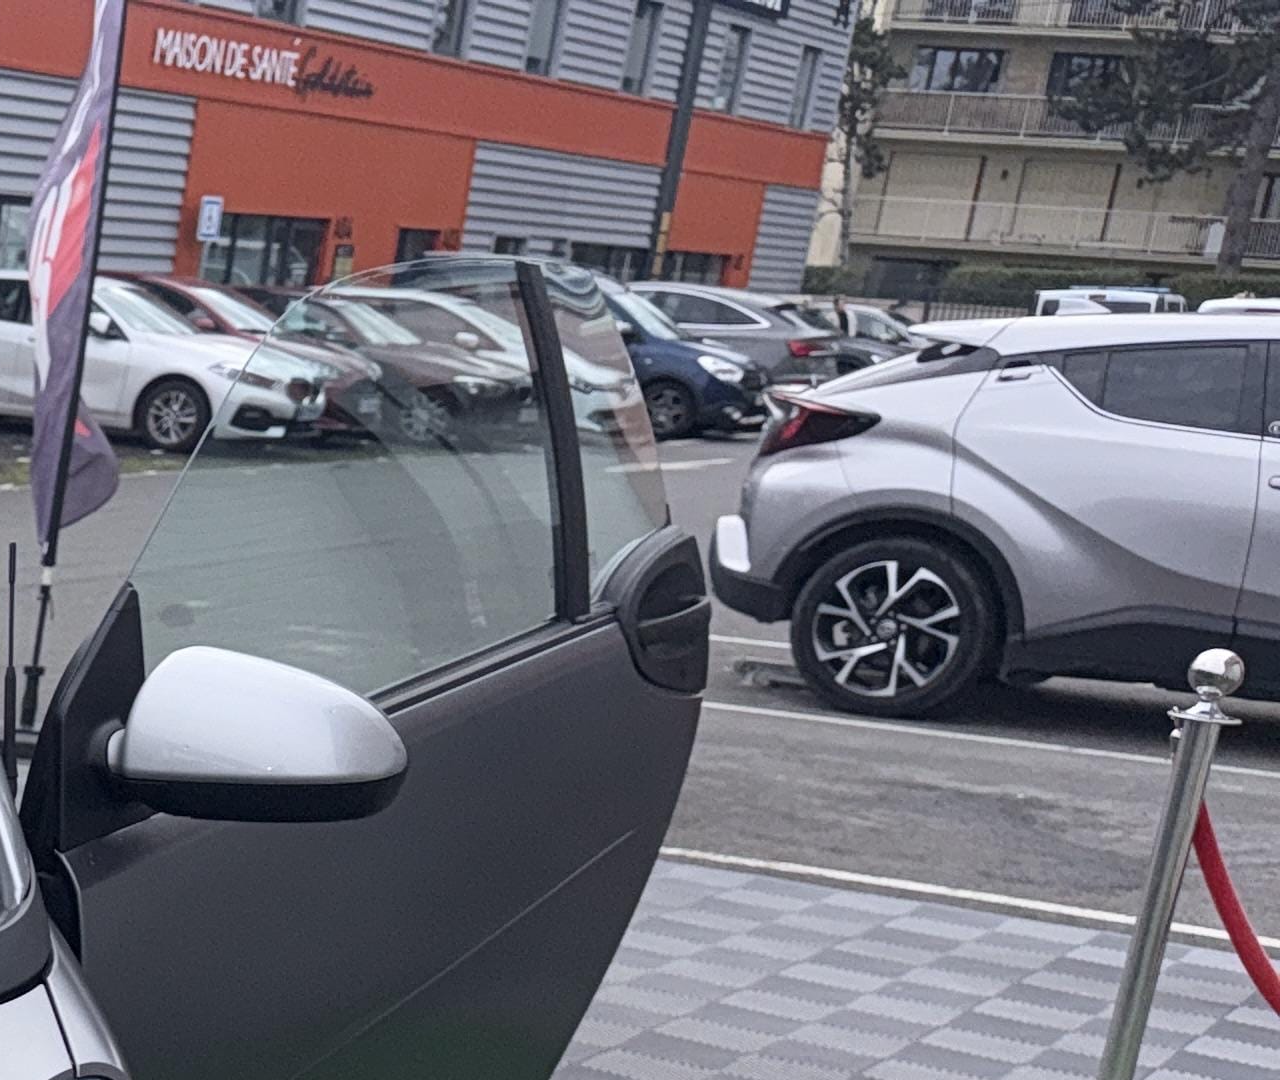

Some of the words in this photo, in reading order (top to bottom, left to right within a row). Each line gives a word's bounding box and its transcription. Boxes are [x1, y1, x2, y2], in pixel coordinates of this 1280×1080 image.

[153, 27, 226, 74] MAISON
[224, 40, 250, 80] DE
[248, 37, 301, 87] SANTÉ
